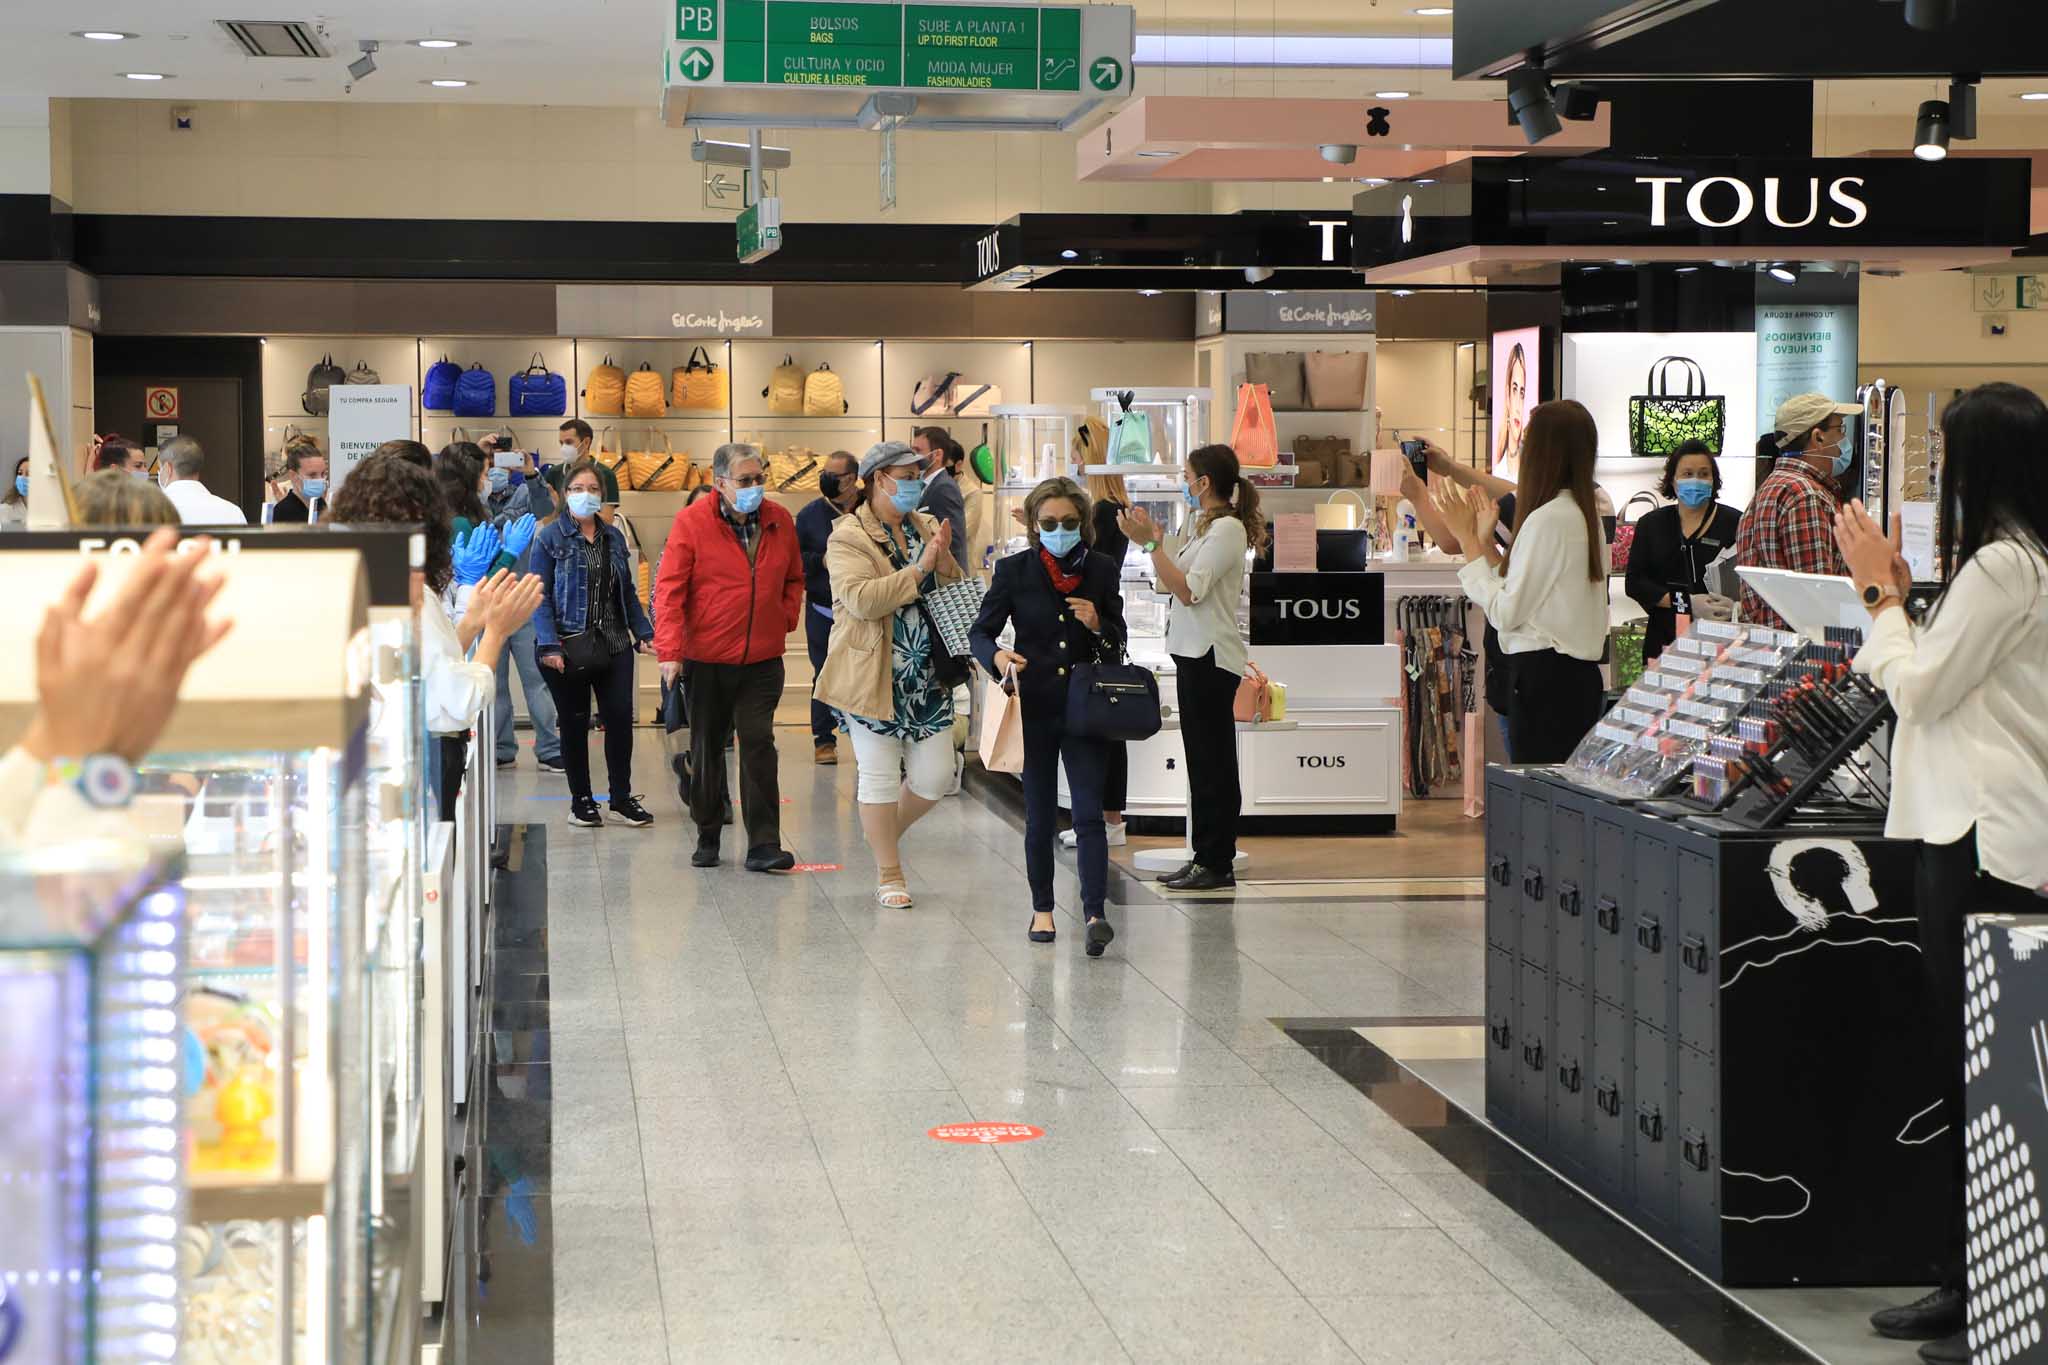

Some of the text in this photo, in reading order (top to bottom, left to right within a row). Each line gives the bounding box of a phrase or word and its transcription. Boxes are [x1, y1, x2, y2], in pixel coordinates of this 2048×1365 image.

[680, 6, 713, 32] PB
[810, 17, 859, 31] BOLSOS
[919, 20, 1025, 33] SUBE A PLANTA 1
[810, 32, 834, 43] BAGS
[918, 35, 998, 47] UP TO FIRST FLOOR
[784, 57, 885, 72] CULTURA Y OCIO
[928, 60, 1013, 75] MODA MUJER
[784, 73, 867, 85] CULTURE & LEISURE
[1635, 176, 1868, 227] TOUS
[977, 230, 1000, 277] TOUS
[672, 313, 686, 328] El
[687, 313, 718, 328] Corte
[1279, 306, 1293, 321] El
[1294, 306, 1325, 321] Corte
[1274, 598, 1361, 621] TOUS
[1296, 755, 1346, 768] TOUS
